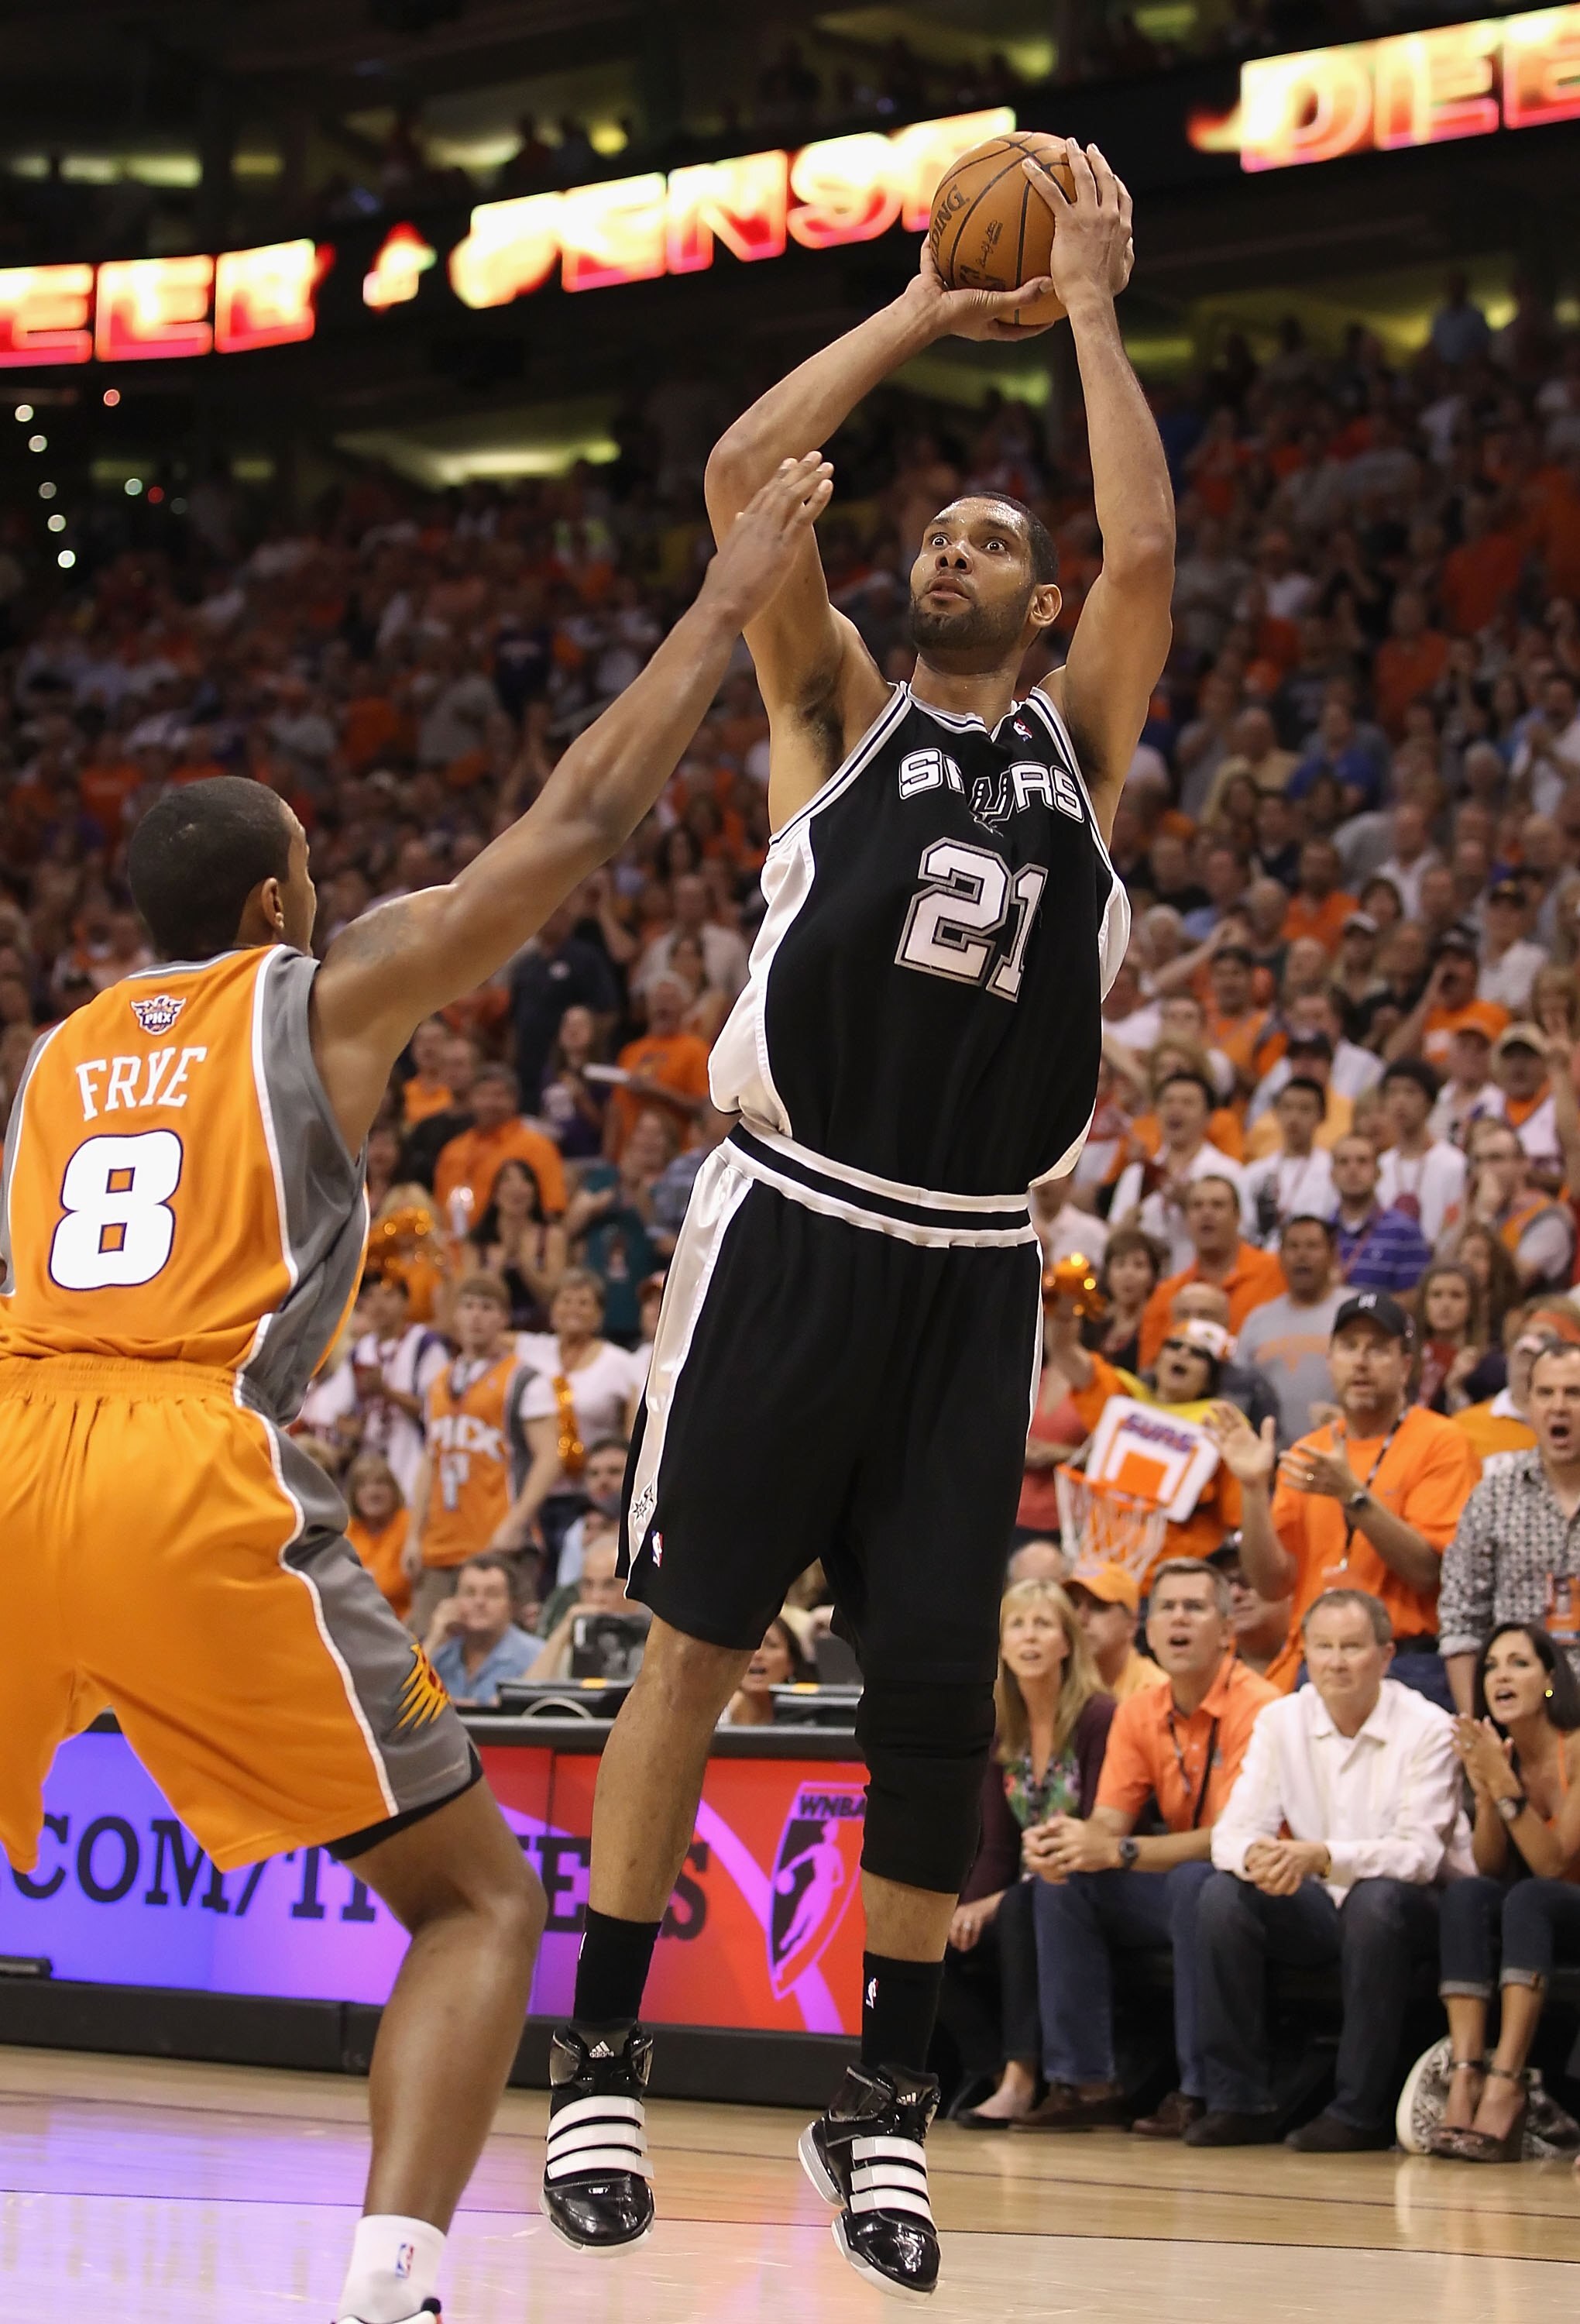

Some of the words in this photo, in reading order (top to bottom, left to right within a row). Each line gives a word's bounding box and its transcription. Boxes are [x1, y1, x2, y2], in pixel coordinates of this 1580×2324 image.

[894, 836, 1049, 1004] 21
[144, 1012, 171, 1024] PHX
[74, 1047, 208, 1122] FRYE
[48, 1129, 184, 1291] 8
